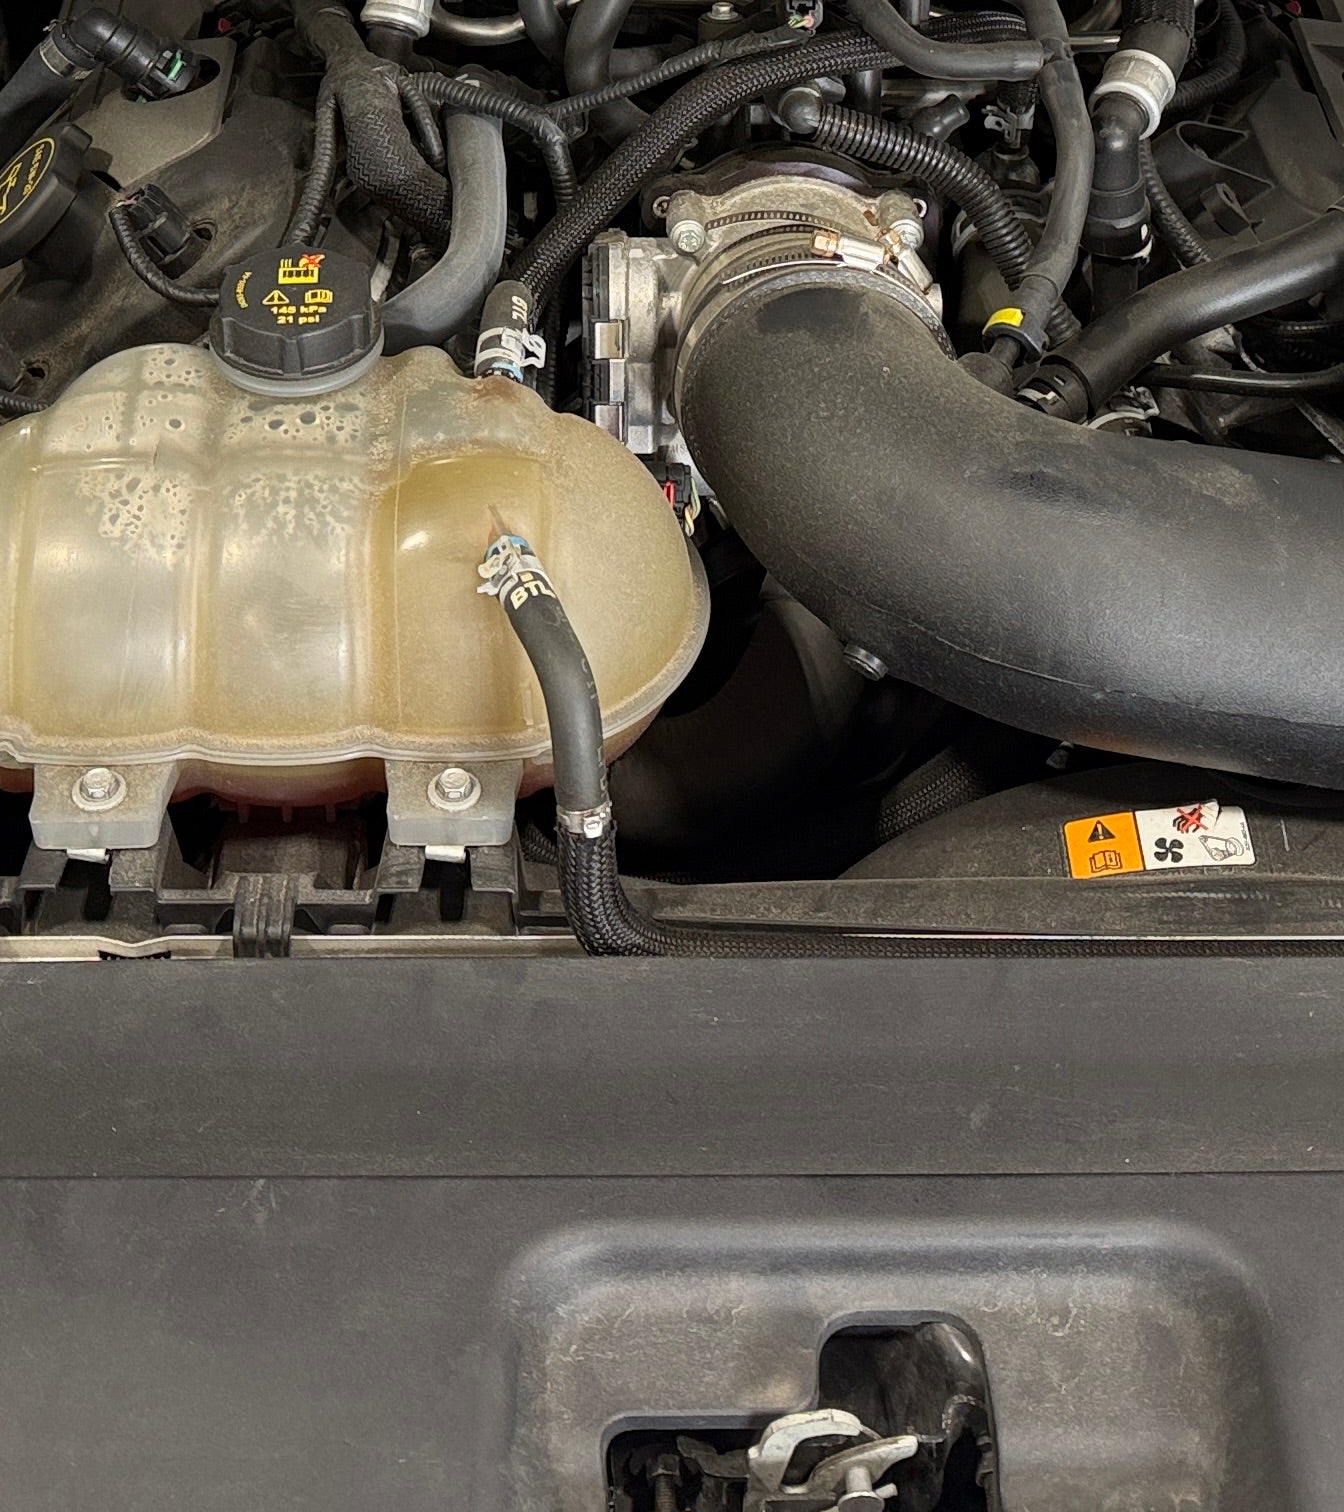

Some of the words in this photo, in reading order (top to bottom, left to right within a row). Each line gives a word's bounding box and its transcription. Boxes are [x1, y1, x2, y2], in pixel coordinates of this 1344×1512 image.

[270, 305, 297, 315] 145
[299, 305, 327, 314] kPa
[276, 315, 294, 324] 21
[298, 314, 320, 325] psi
[509, 581, 557, 611] BTL
